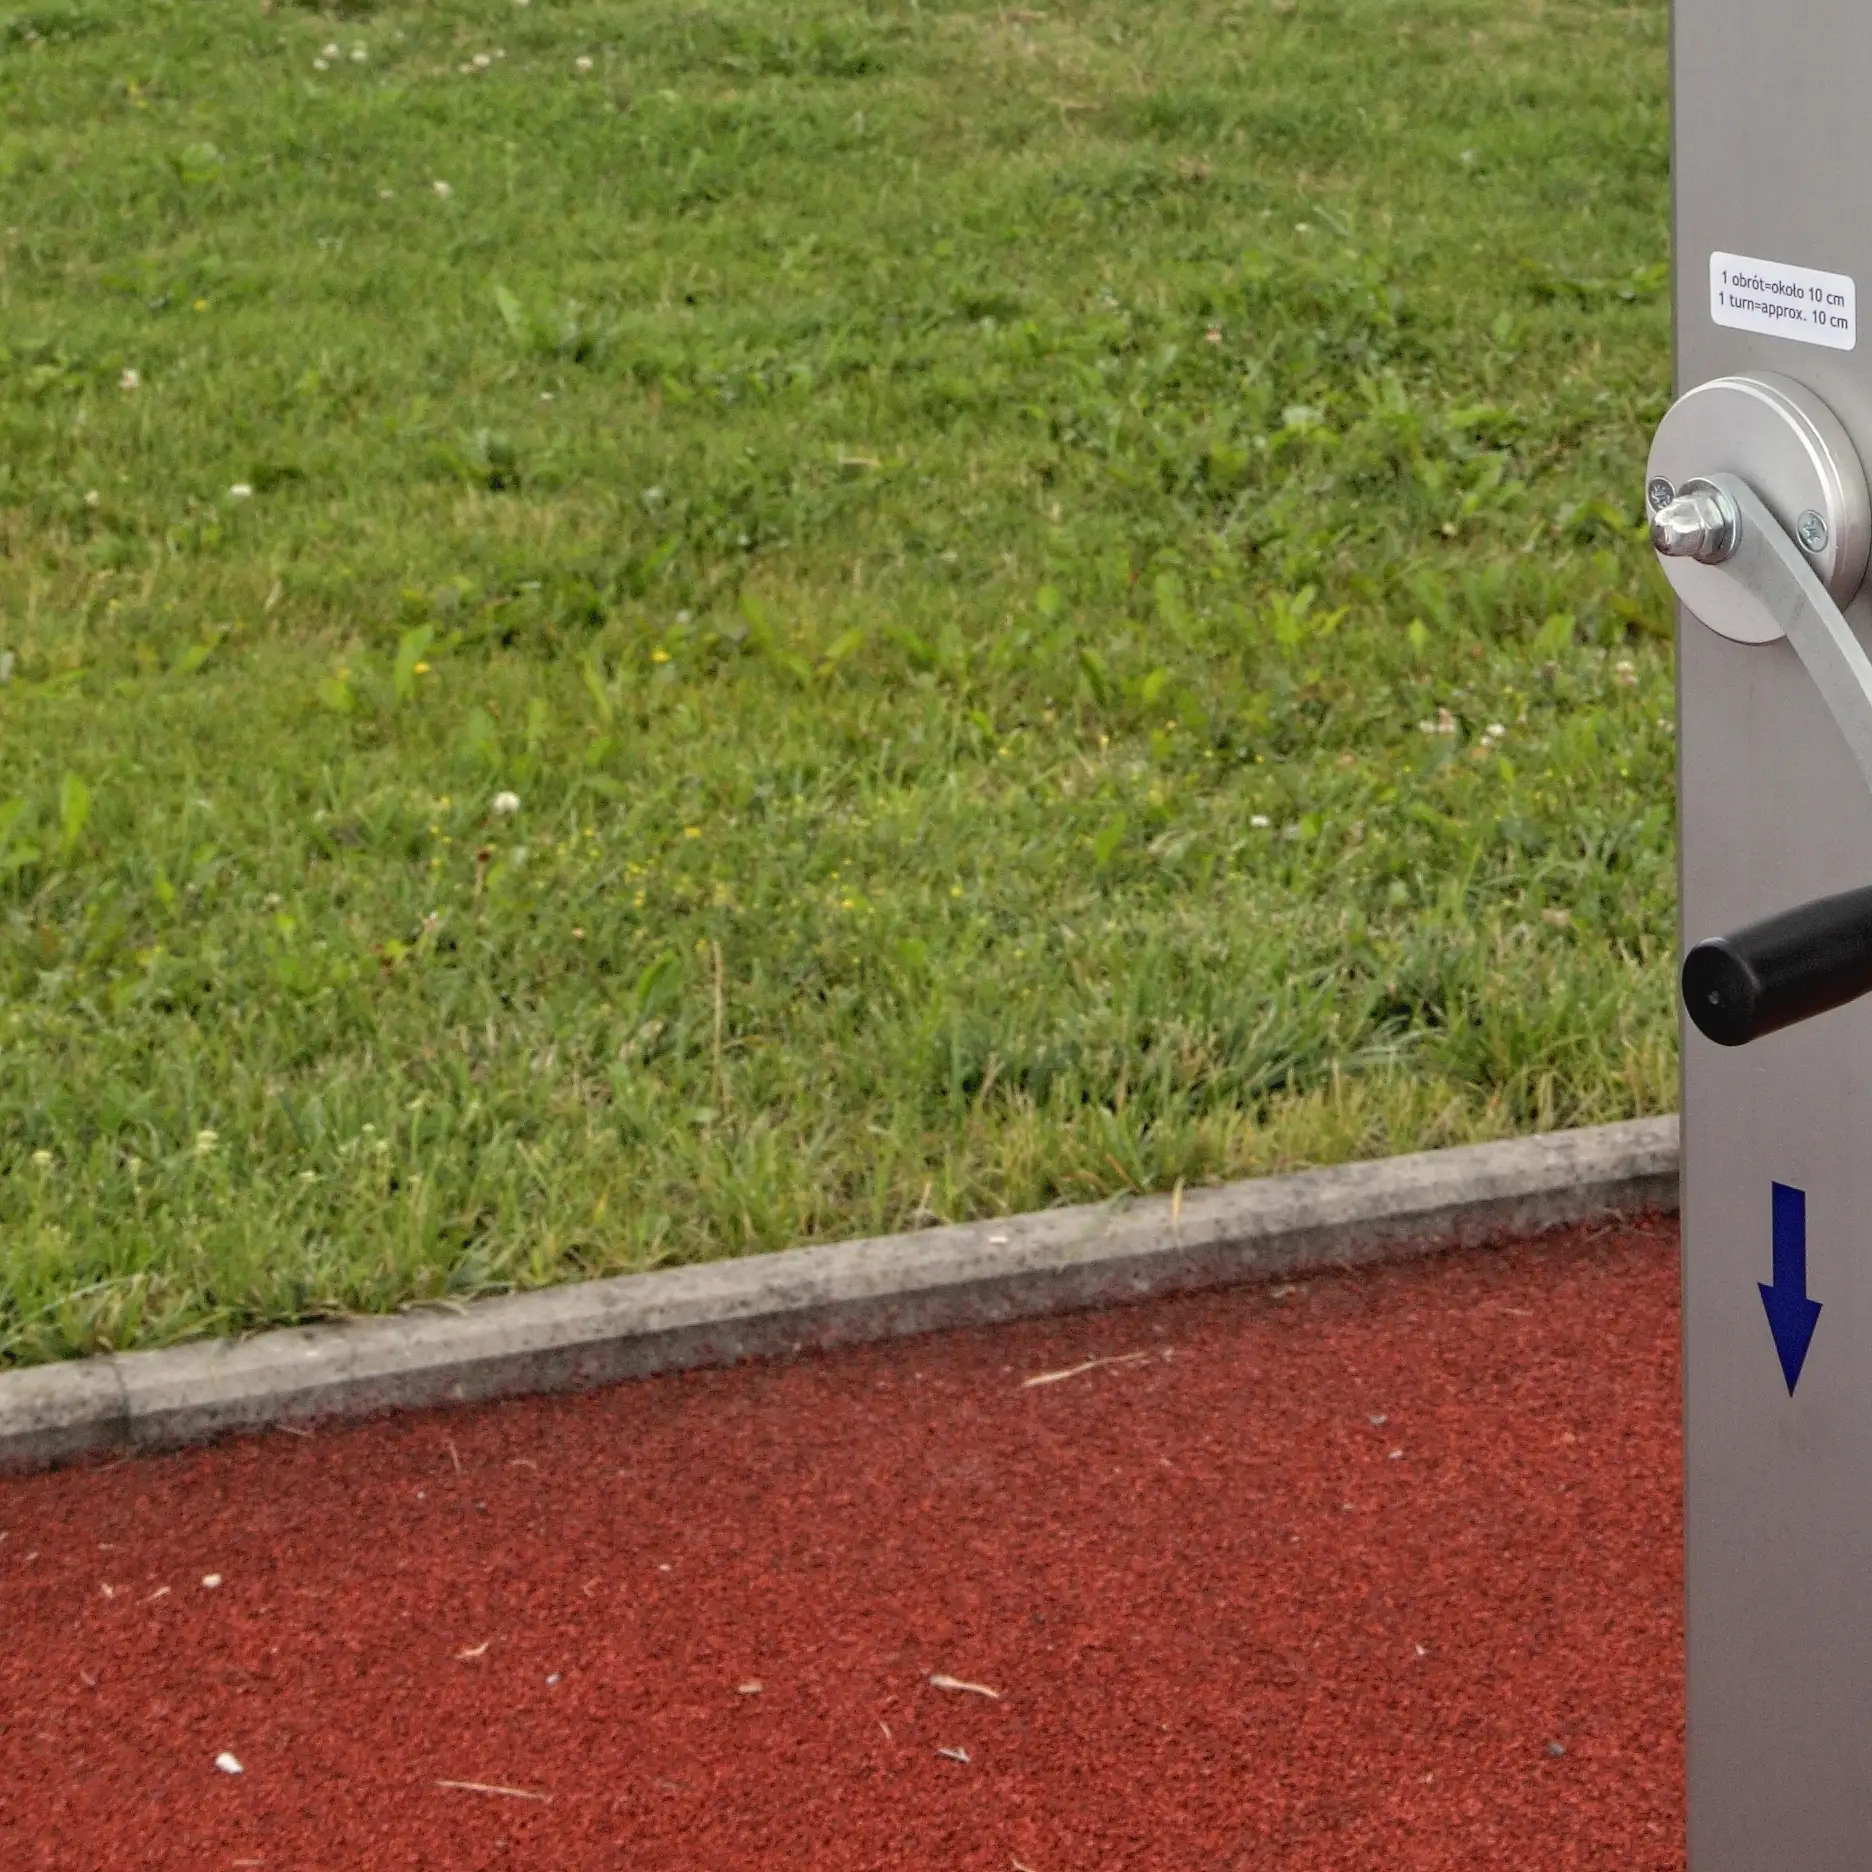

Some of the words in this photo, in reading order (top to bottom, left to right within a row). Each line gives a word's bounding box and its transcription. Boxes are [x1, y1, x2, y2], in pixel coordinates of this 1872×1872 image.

[1721, 270, 1727, 284] 1
[1808, 287, 1823, 303] 10
[1826, 294, 1845, 307] cm
[1719, 292, 1724, 305] 1
[1812, 309, 1827, 326] 10
[1830, 316, 1849, 330] cm
